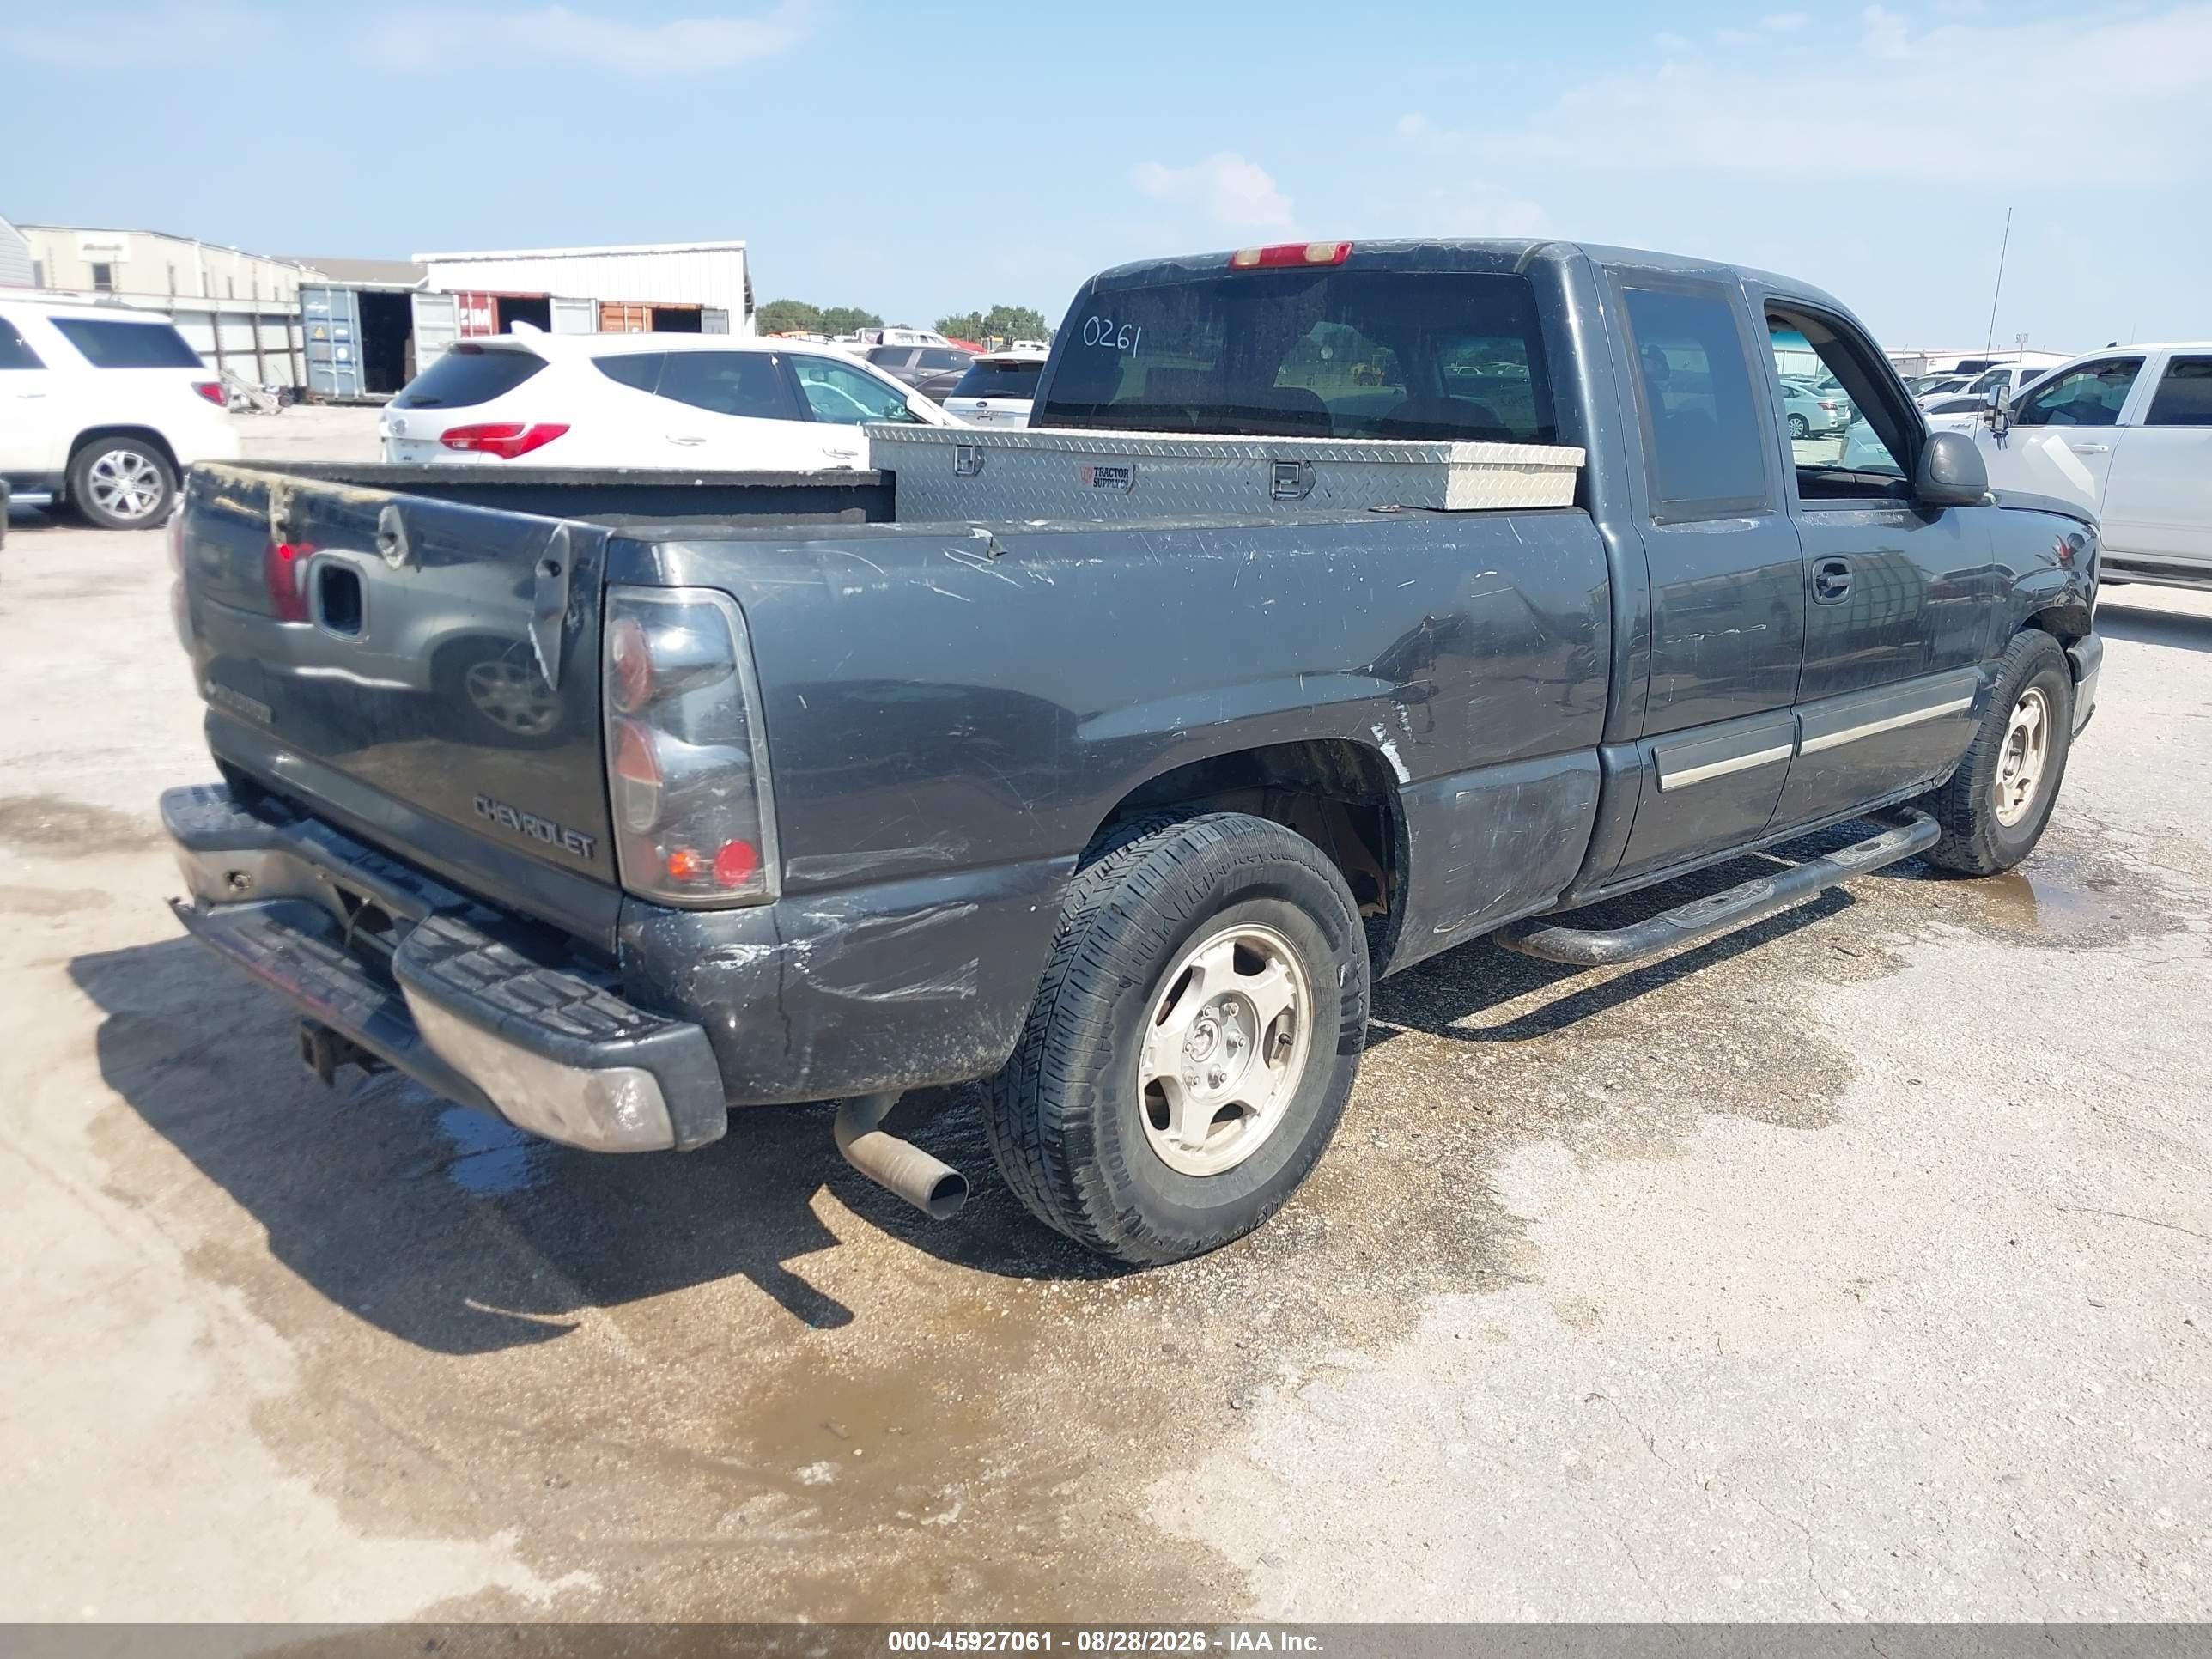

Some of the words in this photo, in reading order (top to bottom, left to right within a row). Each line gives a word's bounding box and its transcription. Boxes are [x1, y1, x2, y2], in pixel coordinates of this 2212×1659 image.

[1084, 316, 1141, 358] 0261
[1093, 477, 1120, 489] SUPPLY
[1094, 466, 1129, 478] TRACTOR
[474, 794, 597, 859] CHEVROLET
